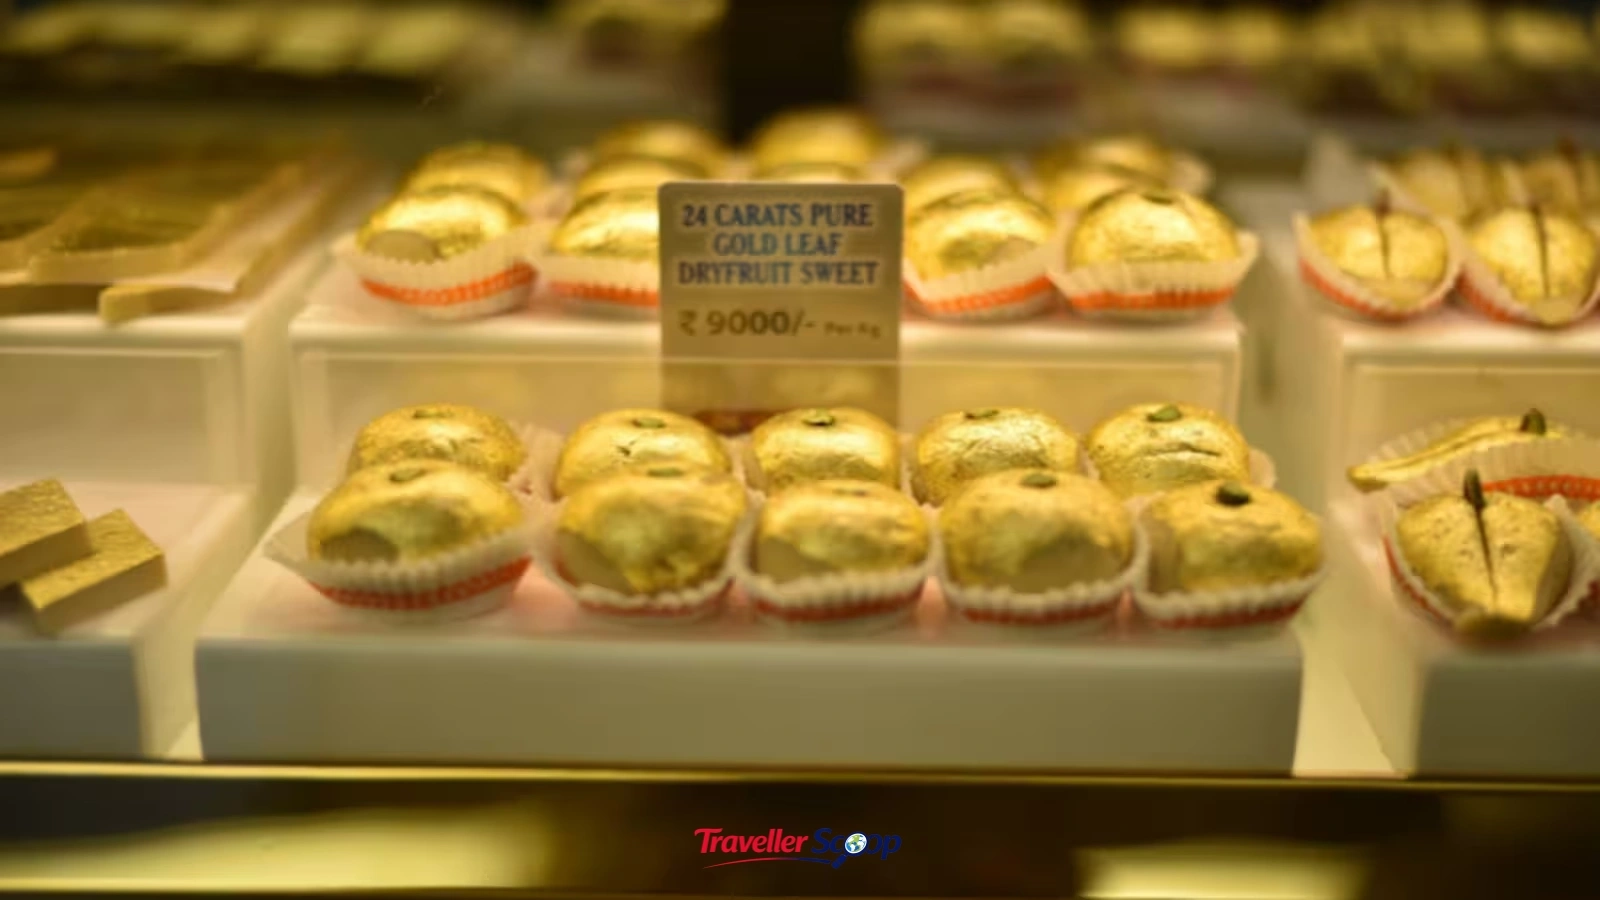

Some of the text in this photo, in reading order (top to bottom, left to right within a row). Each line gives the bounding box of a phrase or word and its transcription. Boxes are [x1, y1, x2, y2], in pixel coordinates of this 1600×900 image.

[682, 203, 873, 227] 24 CARATS PURE
[713, 232, 842, 256] GOLD LEAF
[678, 261, 879, 285] DRYFRUIT SWEET
[706, 309, 816, 337] 9000/-
